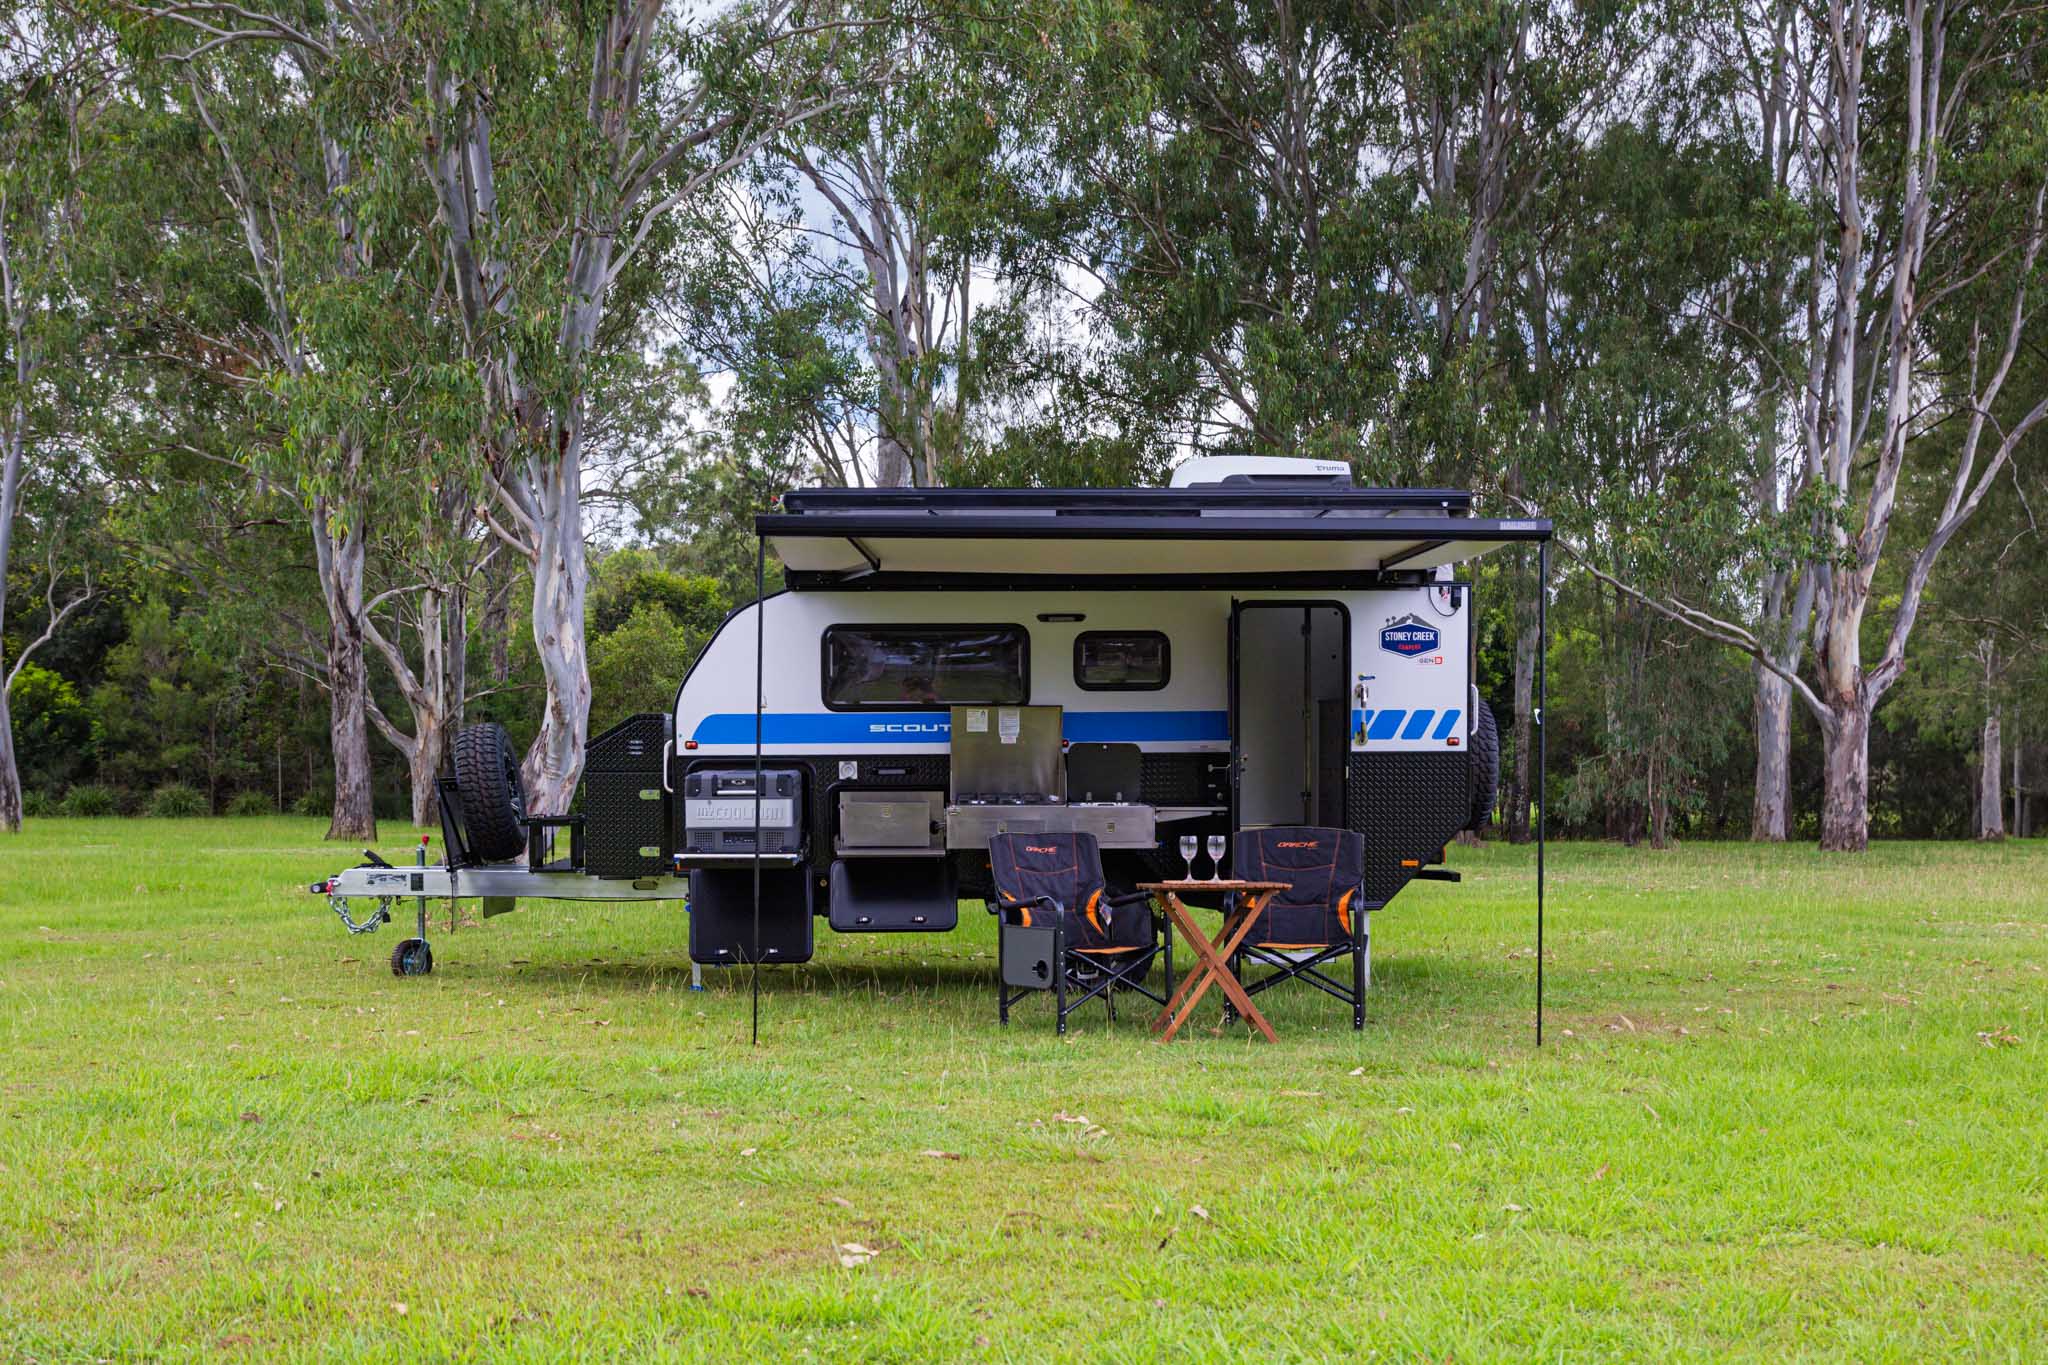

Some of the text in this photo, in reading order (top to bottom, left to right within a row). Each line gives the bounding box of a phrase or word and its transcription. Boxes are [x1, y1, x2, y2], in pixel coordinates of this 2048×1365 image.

[1385, 631, 1435, 641] STONEY CREEK
[869, 723, 952, 733] SCOUT
